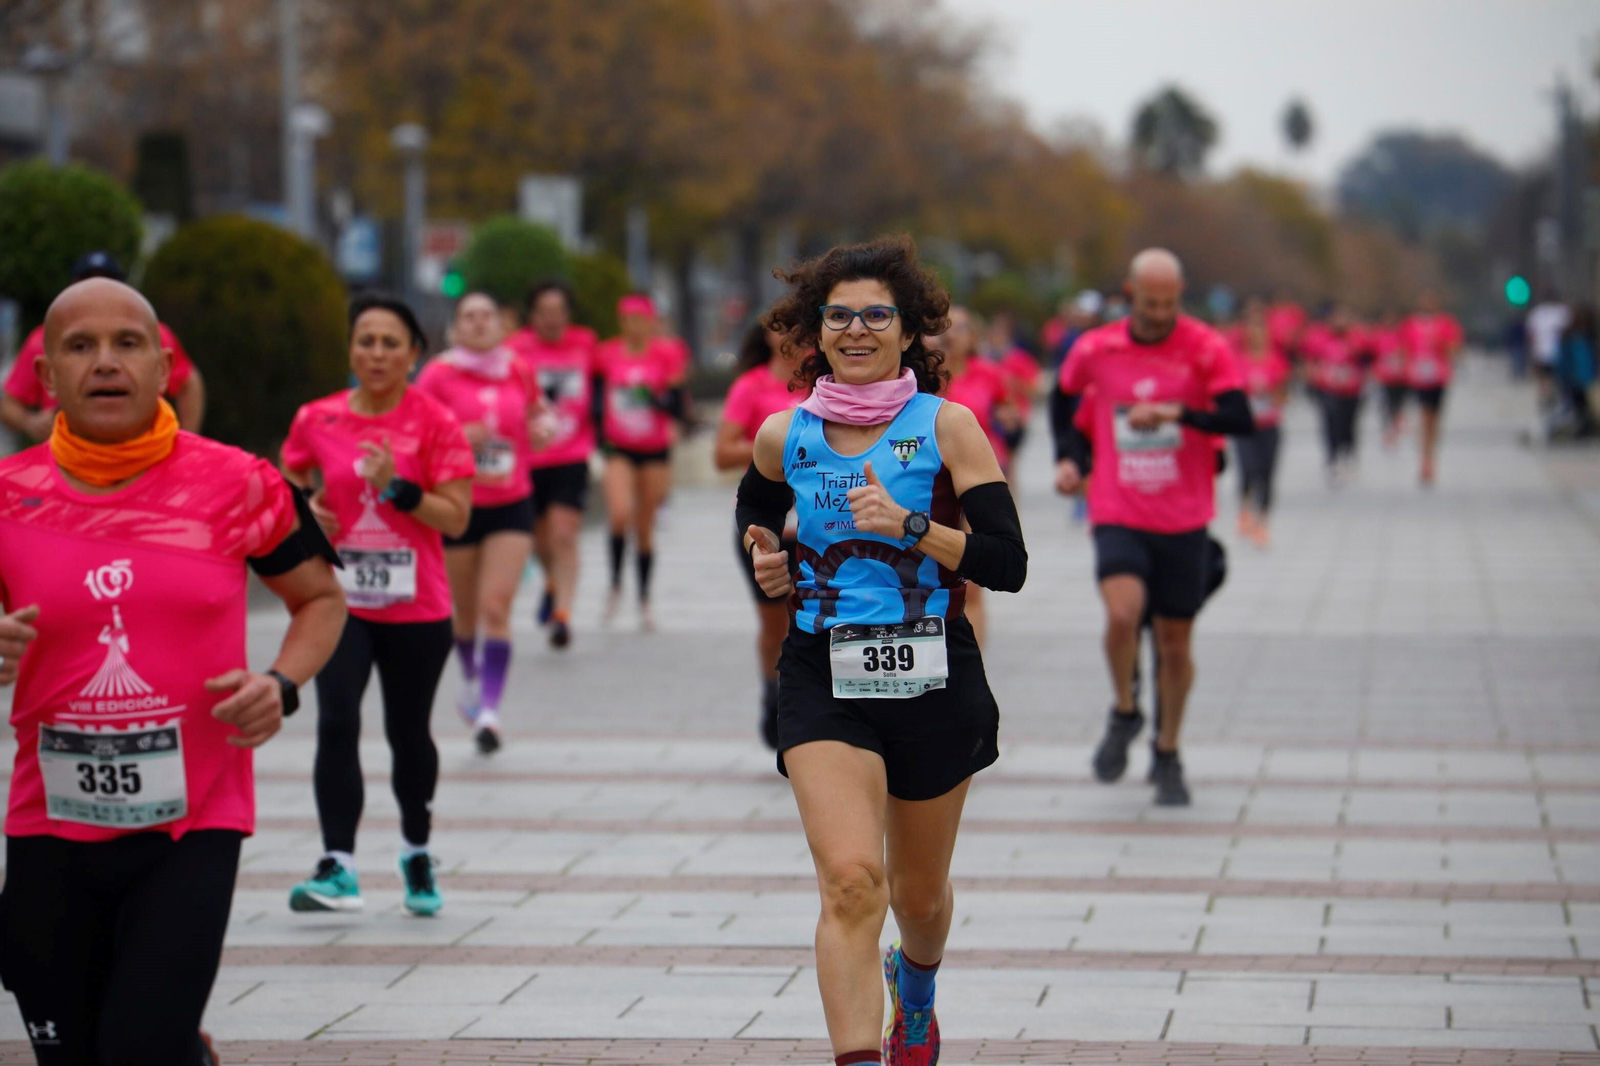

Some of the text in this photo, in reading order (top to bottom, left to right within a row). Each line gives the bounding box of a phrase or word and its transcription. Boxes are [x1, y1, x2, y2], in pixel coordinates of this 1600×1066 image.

[816, 472, 869, 490] Triatlo
[356, 567, 390, 588] 529
[863, 644, 914, 672] 339
[68, 694, 169, 713] VIII EDICIÓN
[76, 762, 141, 795] 335
